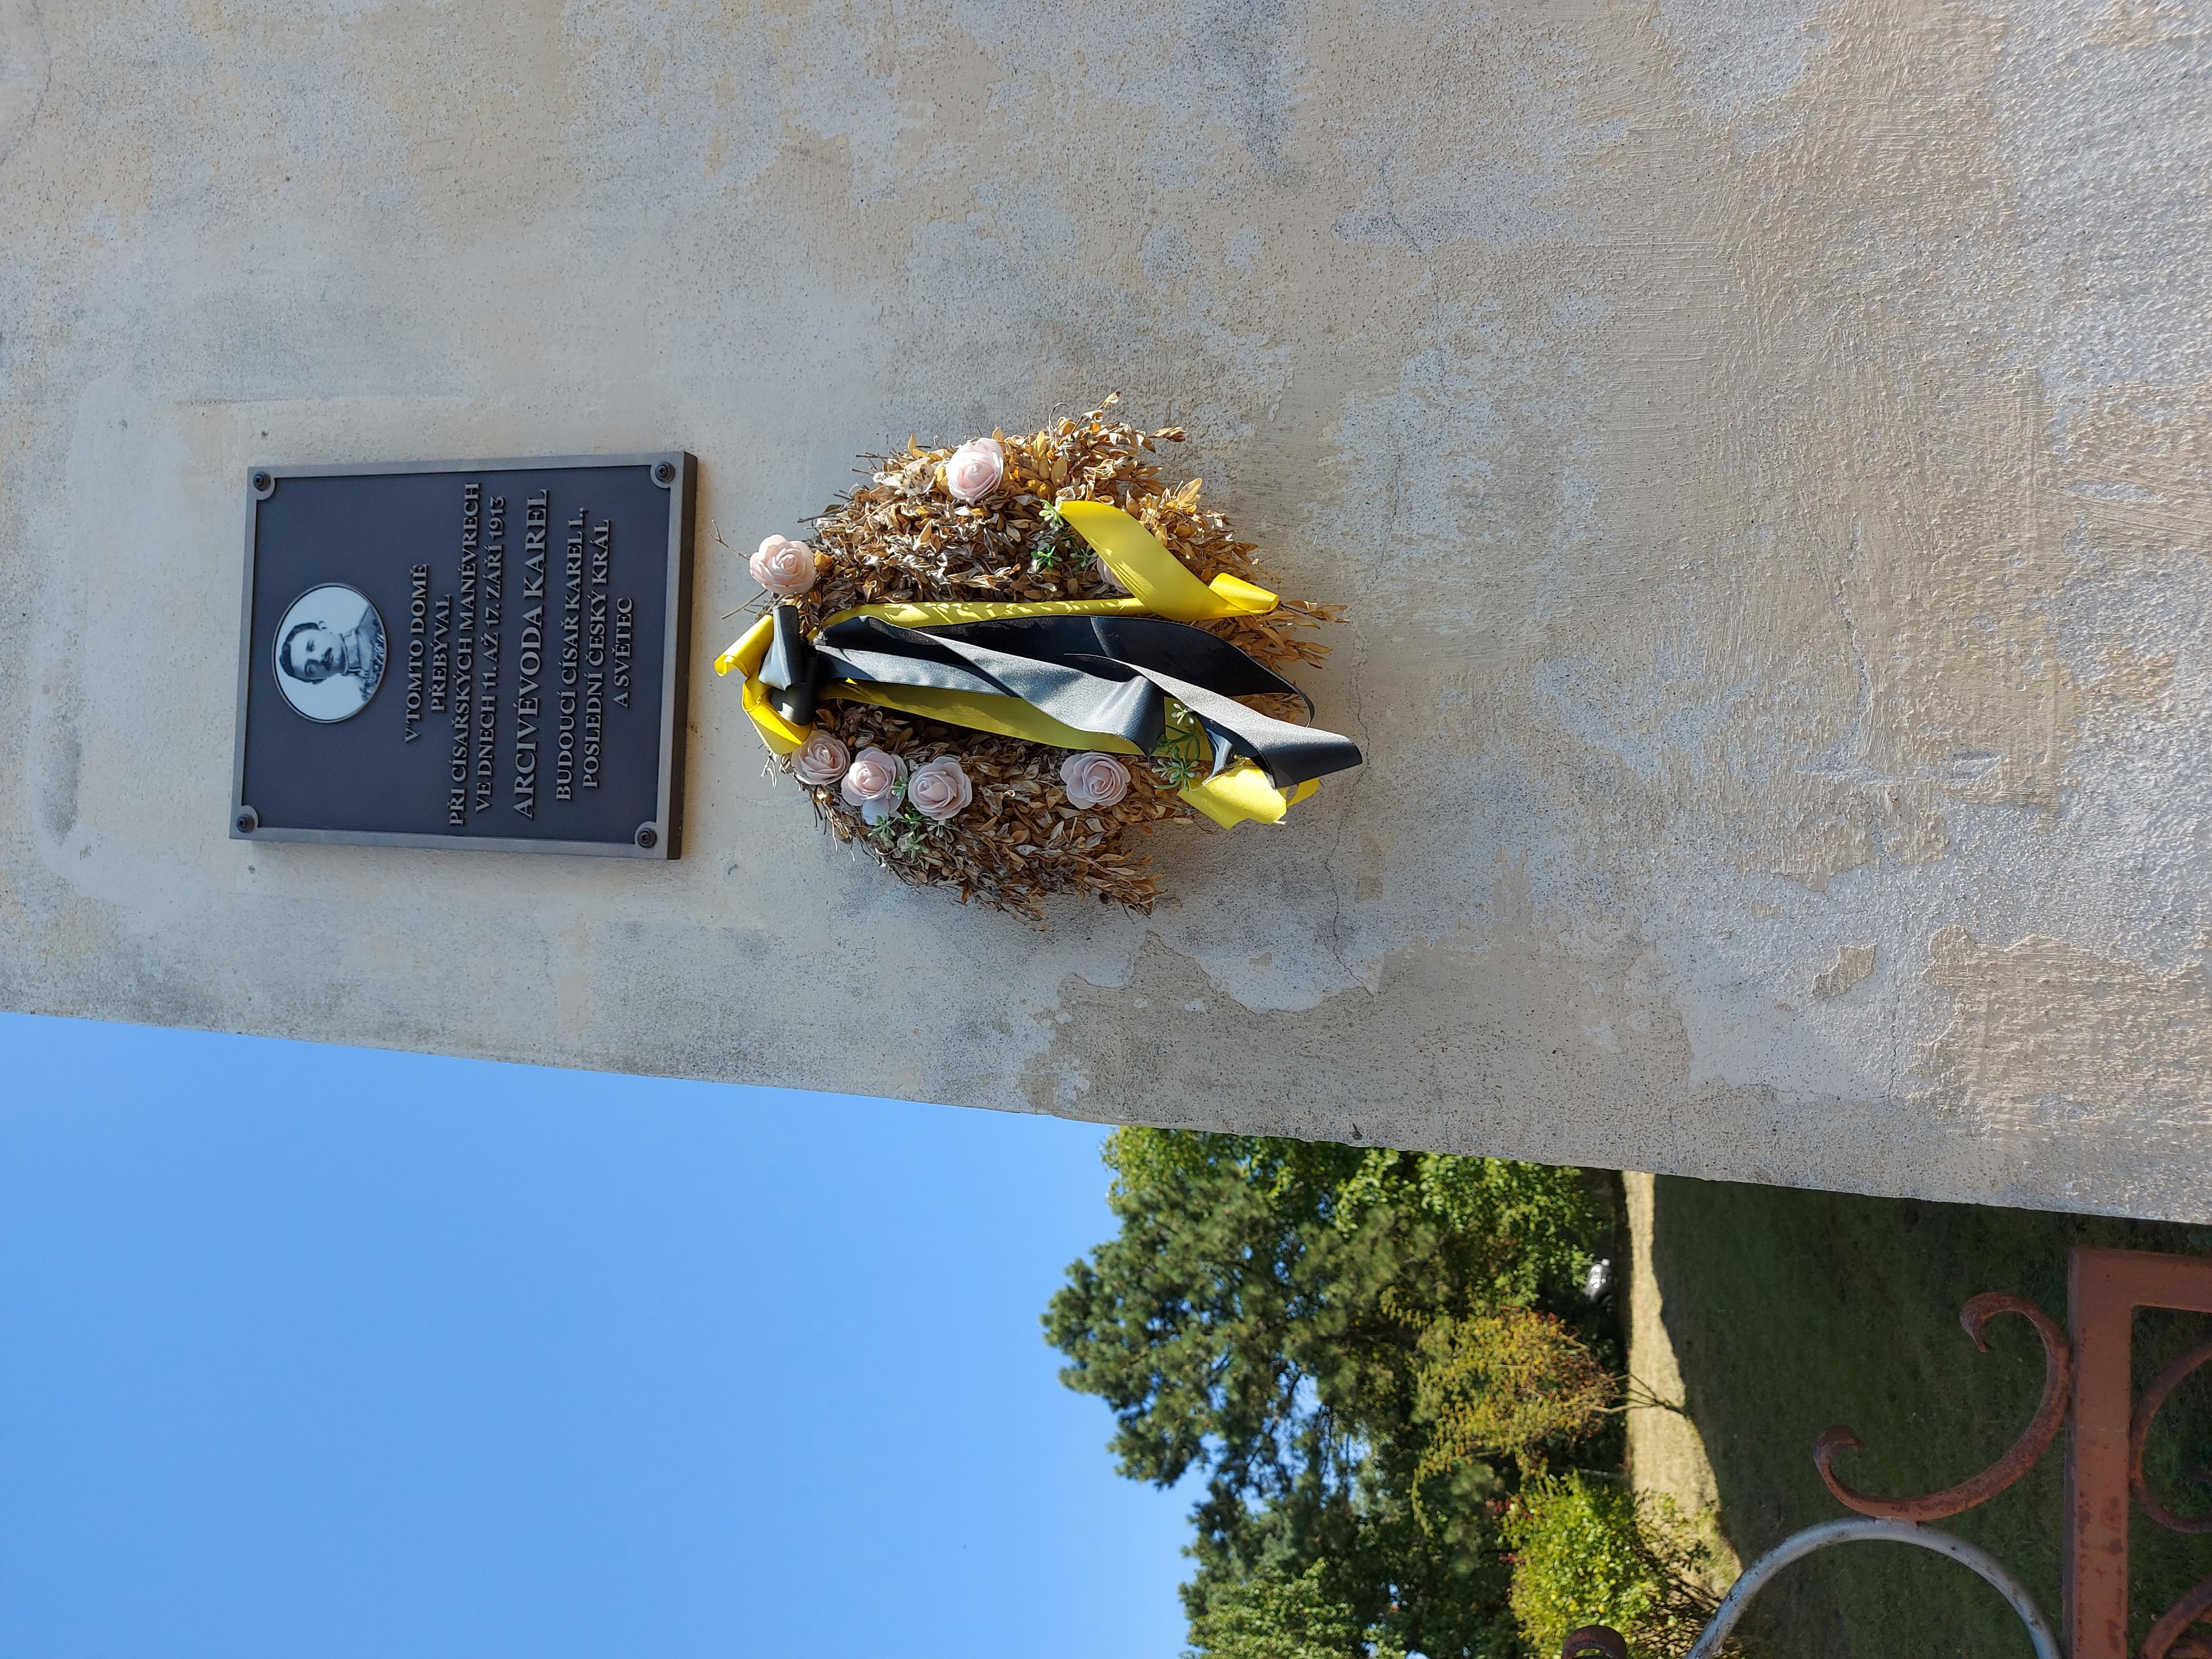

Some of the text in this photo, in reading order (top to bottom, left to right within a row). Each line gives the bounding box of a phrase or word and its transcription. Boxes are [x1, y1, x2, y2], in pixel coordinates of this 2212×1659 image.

[405, 565, 428, 743] V TOMTO DOMĚ
[428, 595, 450, 712] PŘEBÝVAL
[447, 483, 480, 825] PŘI CÍSAŘSKÝCH MANÉVRECH
[475, 497, 505, 812] VE DNECH 11. AŽ 17. ZÁŘÍ 1913
[513, 489, 548, 820] ARCIVÉVODA KAREL
[556, 508, 587, 800] BUDOUCÍ CÍSAŘ KAREL I.,
[582, 520, 610, 789] POSLEDNÍ ČESKÝ KRÁL
[611, 597, 632, 709] A SVĚTEC
